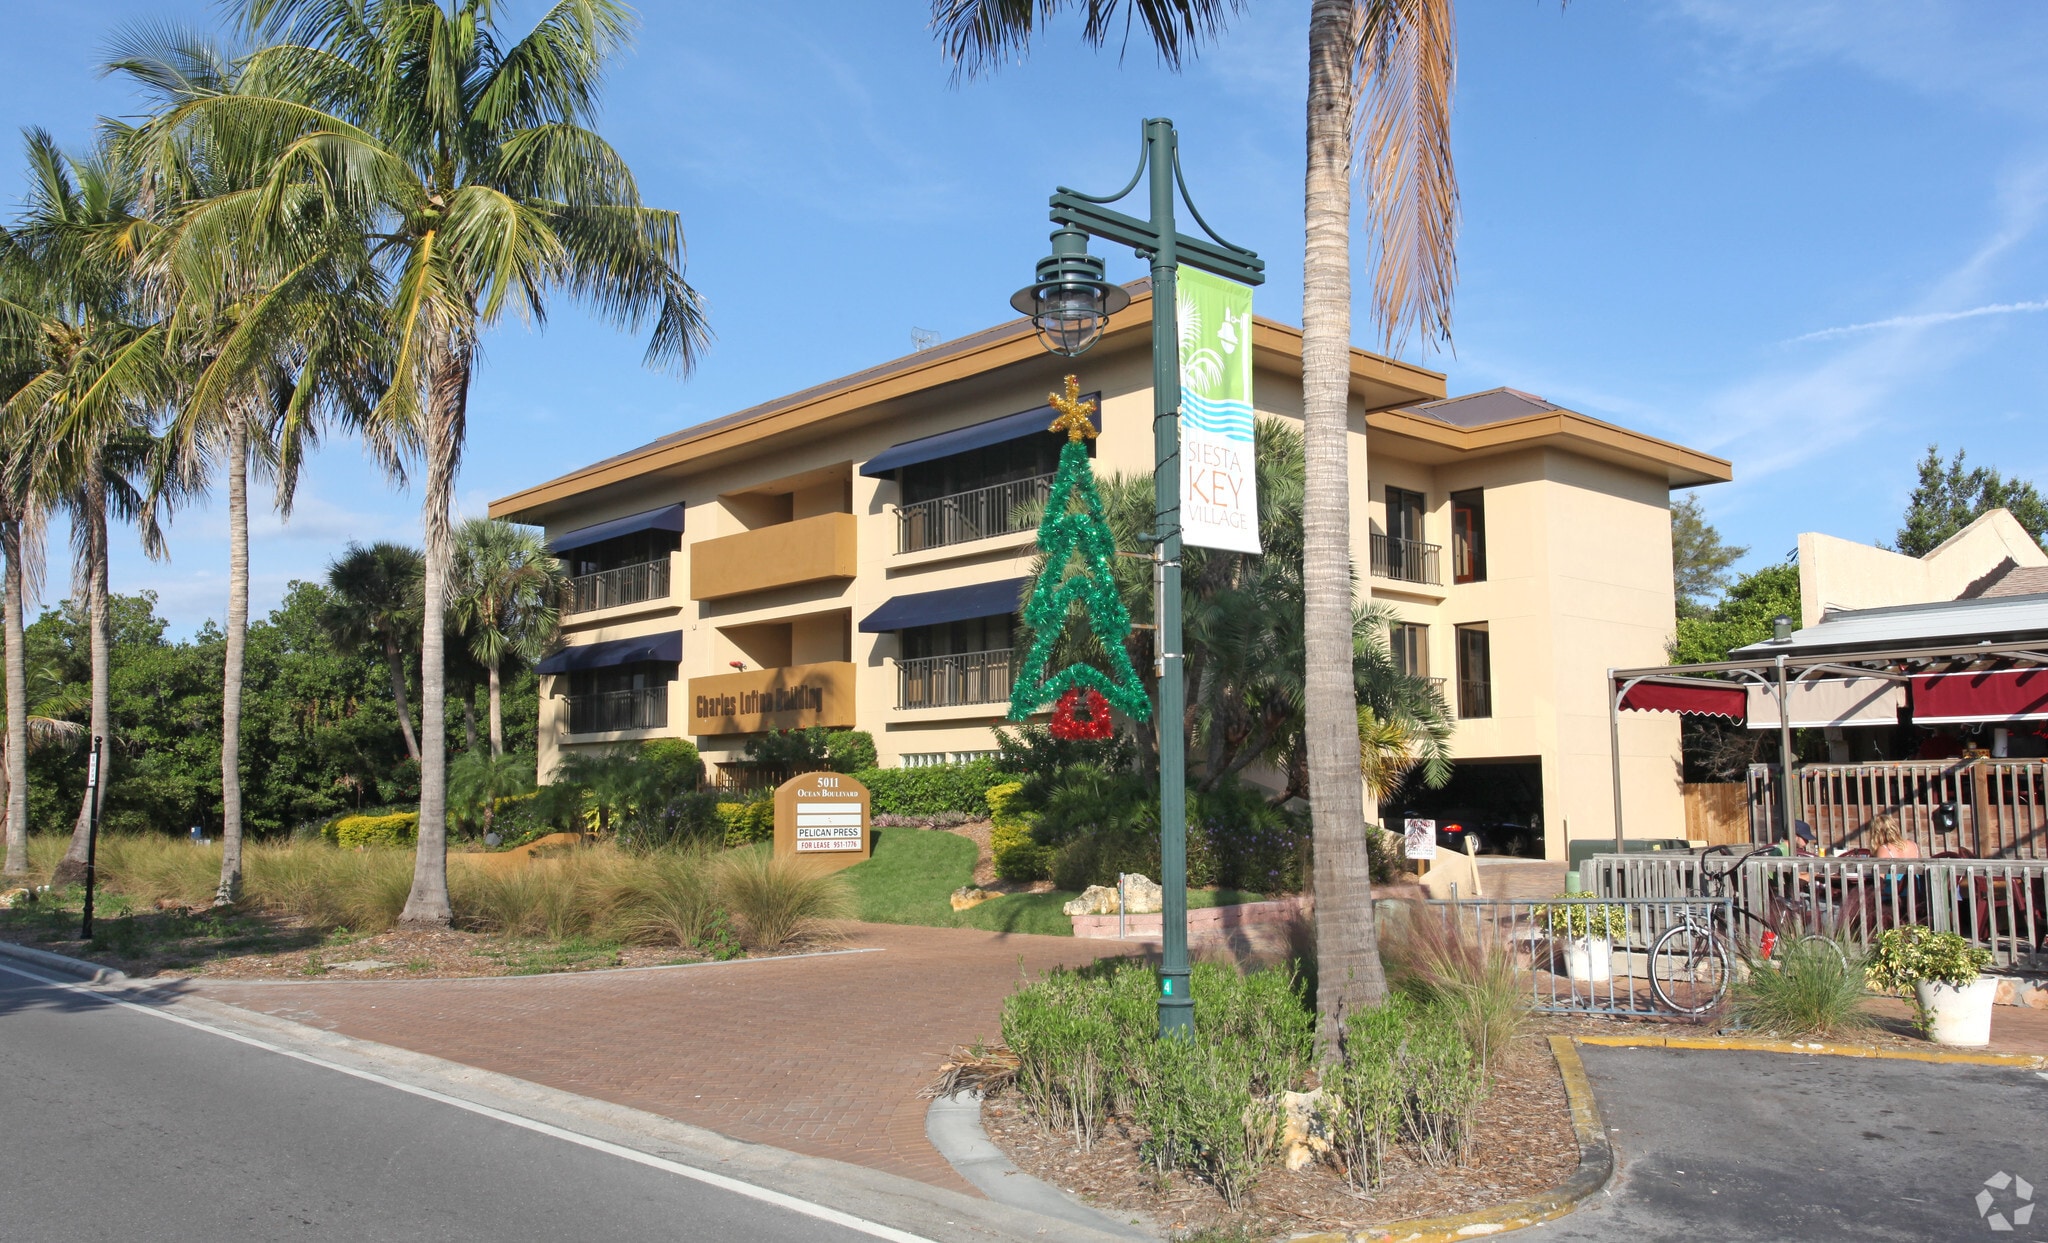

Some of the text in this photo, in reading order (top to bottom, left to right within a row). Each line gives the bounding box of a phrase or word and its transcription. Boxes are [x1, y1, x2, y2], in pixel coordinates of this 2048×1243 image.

[1188, 441, 1242, 473] SIESTA
[1189, 465, 1244, 510] KEY
[1188, 504, 1248, 530] VILLAGE
[696, 692, 736, 718] Charles
[775, 684, 823, 713] Building
[817, 777, 839, 788] 5011
[797, 788, 859, 798] OCEAN BOULEVARD
[799, 827, 859, 837] PELICAN PRESS
[813, 841, 830, 849] LEASE
[833, 840, 857, 849] 951-1776
